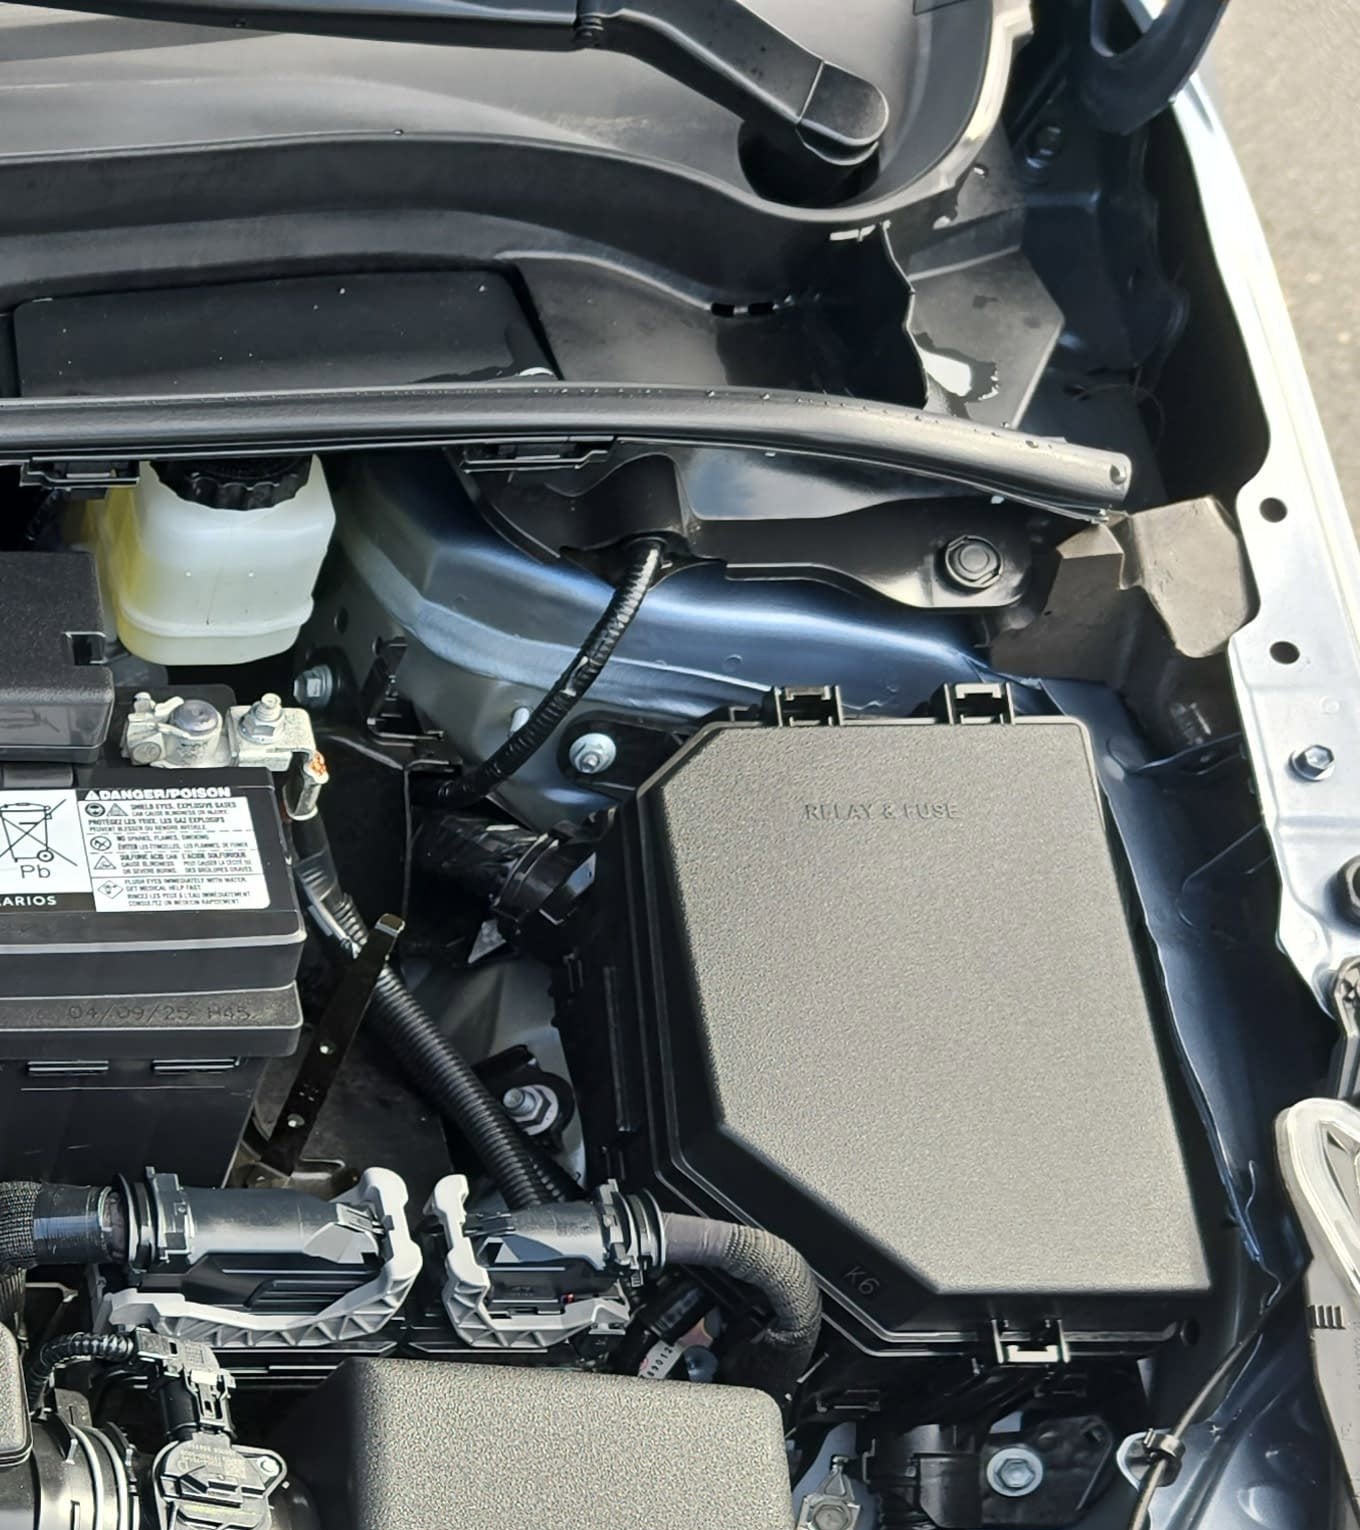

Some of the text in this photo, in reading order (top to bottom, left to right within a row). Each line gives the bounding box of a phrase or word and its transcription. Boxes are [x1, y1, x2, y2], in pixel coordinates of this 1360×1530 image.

[98, 787, 231, 800] DANGER/POISON
[903, 803, 961, 820] FUSE
[20, 864, 51, 879] Pb
